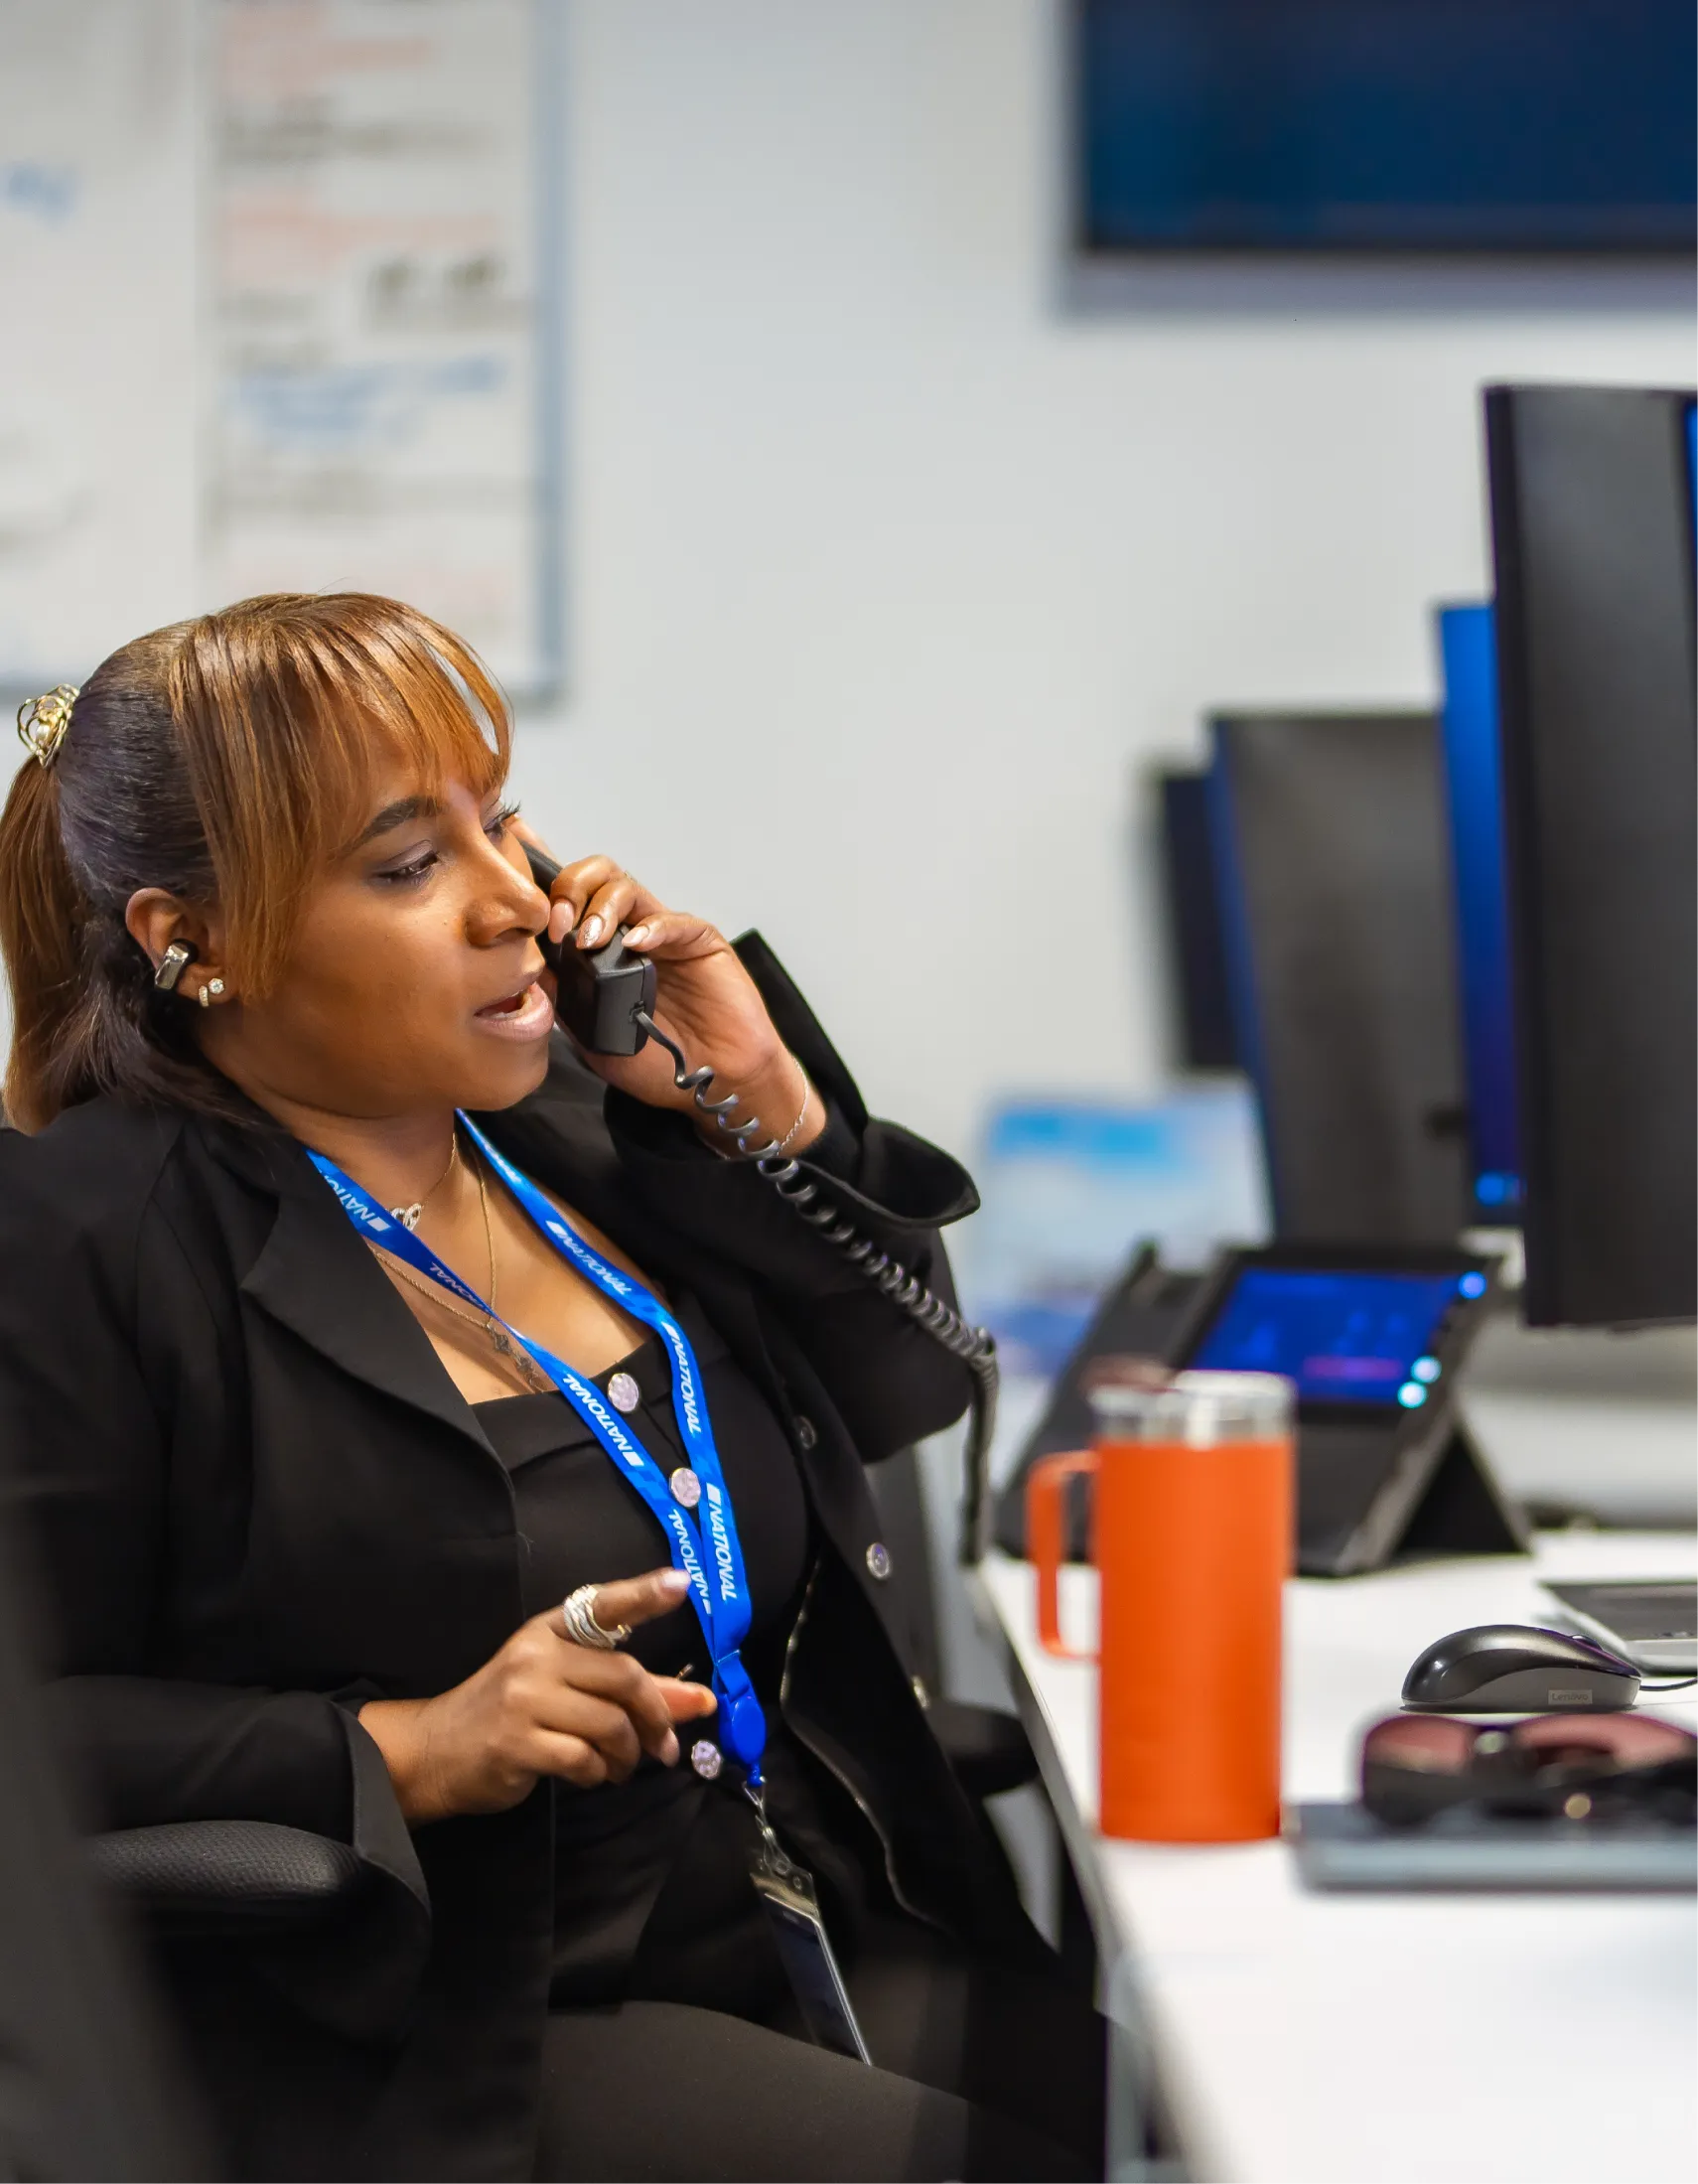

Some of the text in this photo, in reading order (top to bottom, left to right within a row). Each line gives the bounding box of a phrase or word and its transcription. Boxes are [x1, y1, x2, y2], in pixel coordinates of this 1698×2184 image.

[320, 1175, 376, 1221] NATIO
[563, 1374, 634, 1455] NATIONAL
[671, 1335, 702, 1435] NATIONAL
[667, 1508, 710, 1598] NATIONAL
[707, 1504, 738, 1602] NATIONAL
[1551, 1692, 1589, 1701] Lenovo
